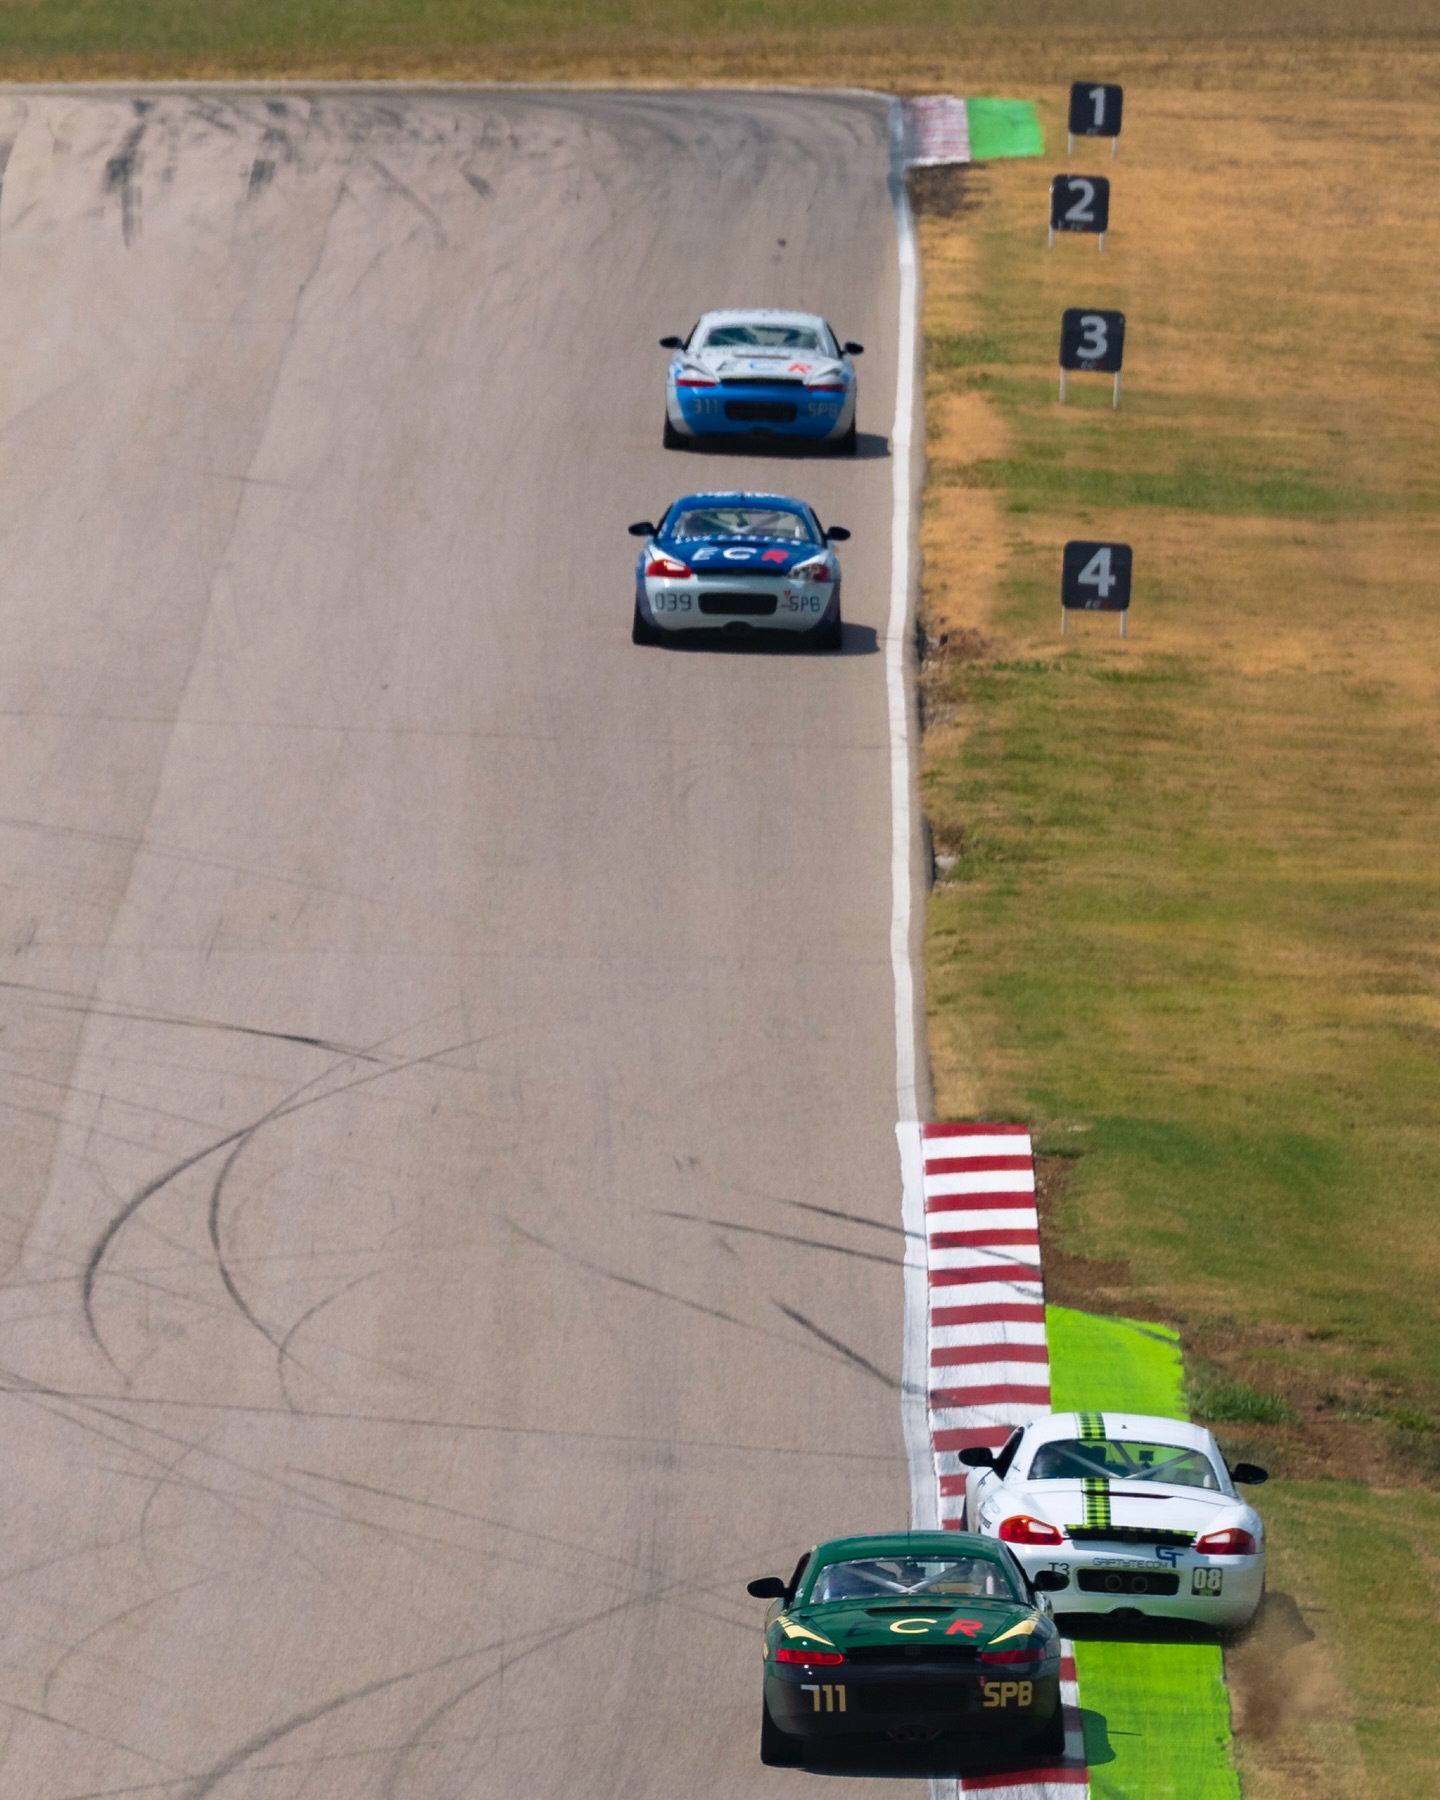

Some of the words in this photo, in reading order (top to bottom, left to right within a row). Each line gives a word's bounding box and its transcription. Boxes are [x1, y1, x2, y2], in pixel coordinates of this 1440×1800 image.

[1089, 86, 1106, 126] 1
[1065, 178, 1095, 222] 2
[1076, 315, 1108, 359] 3
[693, 398, 719, 414] 311
[691, 546, 789, 564] ECR
[1077, 547, 1116, 597] 4
[654, 592, 692, 612] 039
[788, 595, 820, 612] SPB
[1048, 1562, 1071, 1576] T3
[1155, 1545, 1185, 1569] GT
[1194, 1568, 1221, 1590] 08
[801, 1684, 847, 1712] 711
[982, 1680, 1033, 1708] SPB
